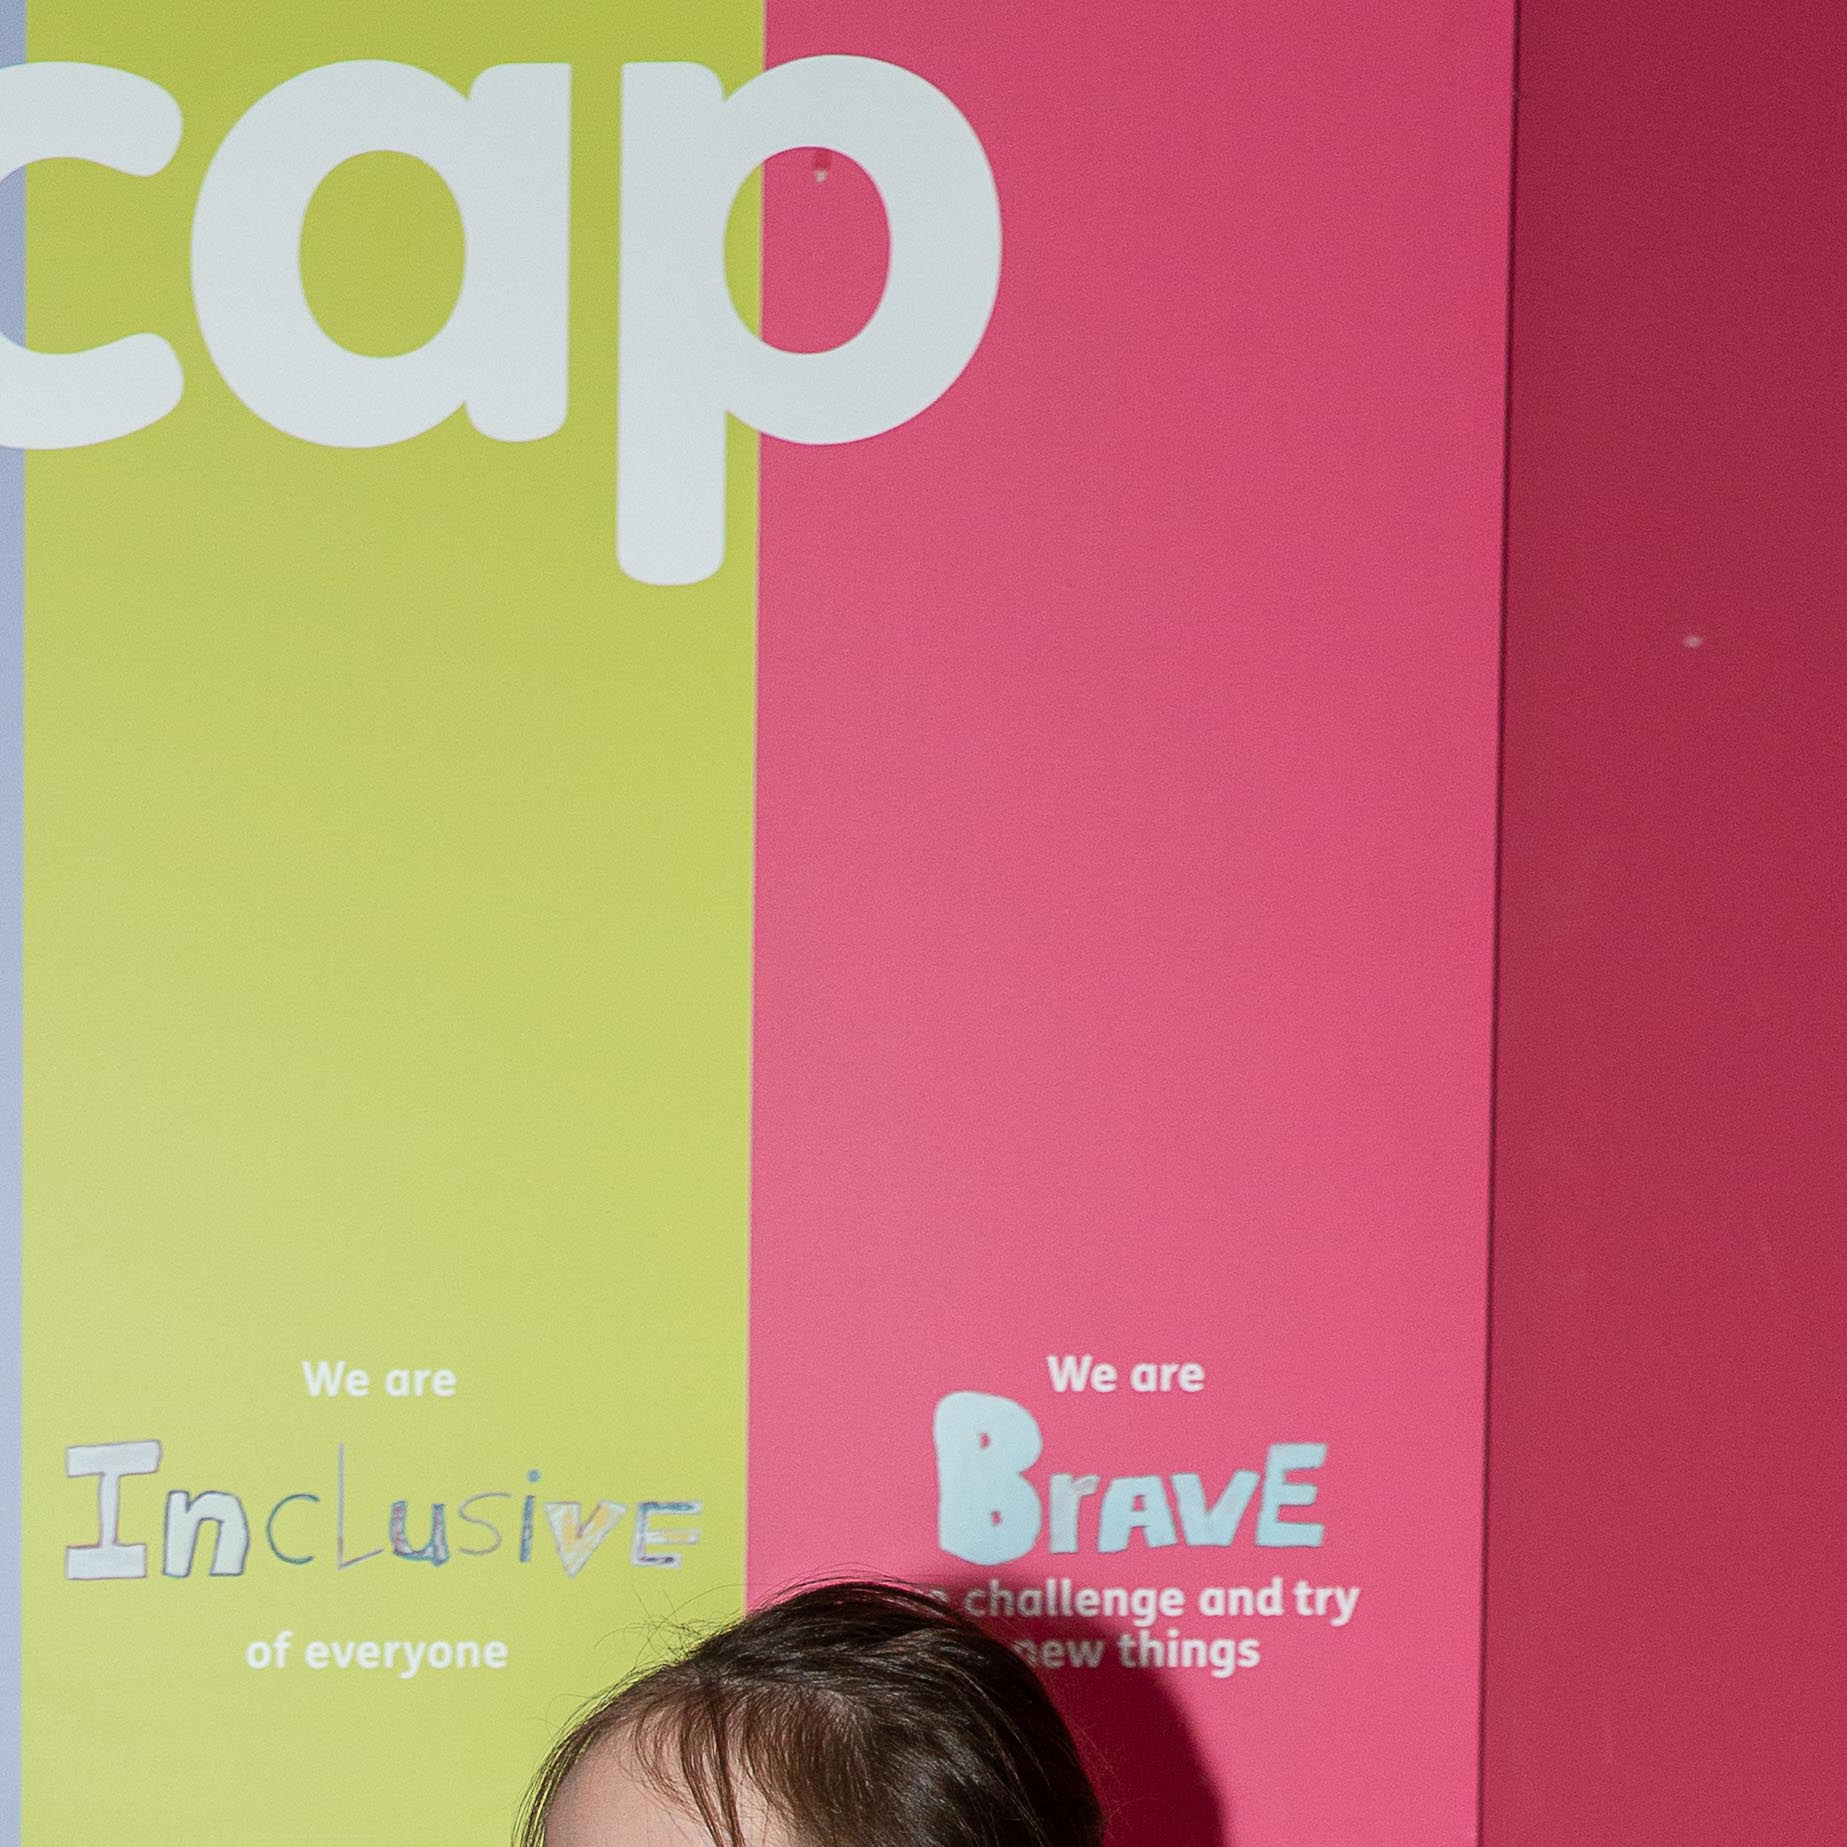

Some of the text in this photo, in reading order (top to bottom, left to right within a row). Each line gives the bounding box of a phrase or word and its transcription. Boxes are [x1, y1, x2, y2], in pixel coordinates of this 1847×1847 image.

[301, 1361, 458, 1398] We are
[1047, 1354, 1205, 1393] We are
[964, 1578, 1361, 1627] challenge and try
[245, 1631, 510, 1679] of everyone
[1118, 1629, 1261, 1678] things
